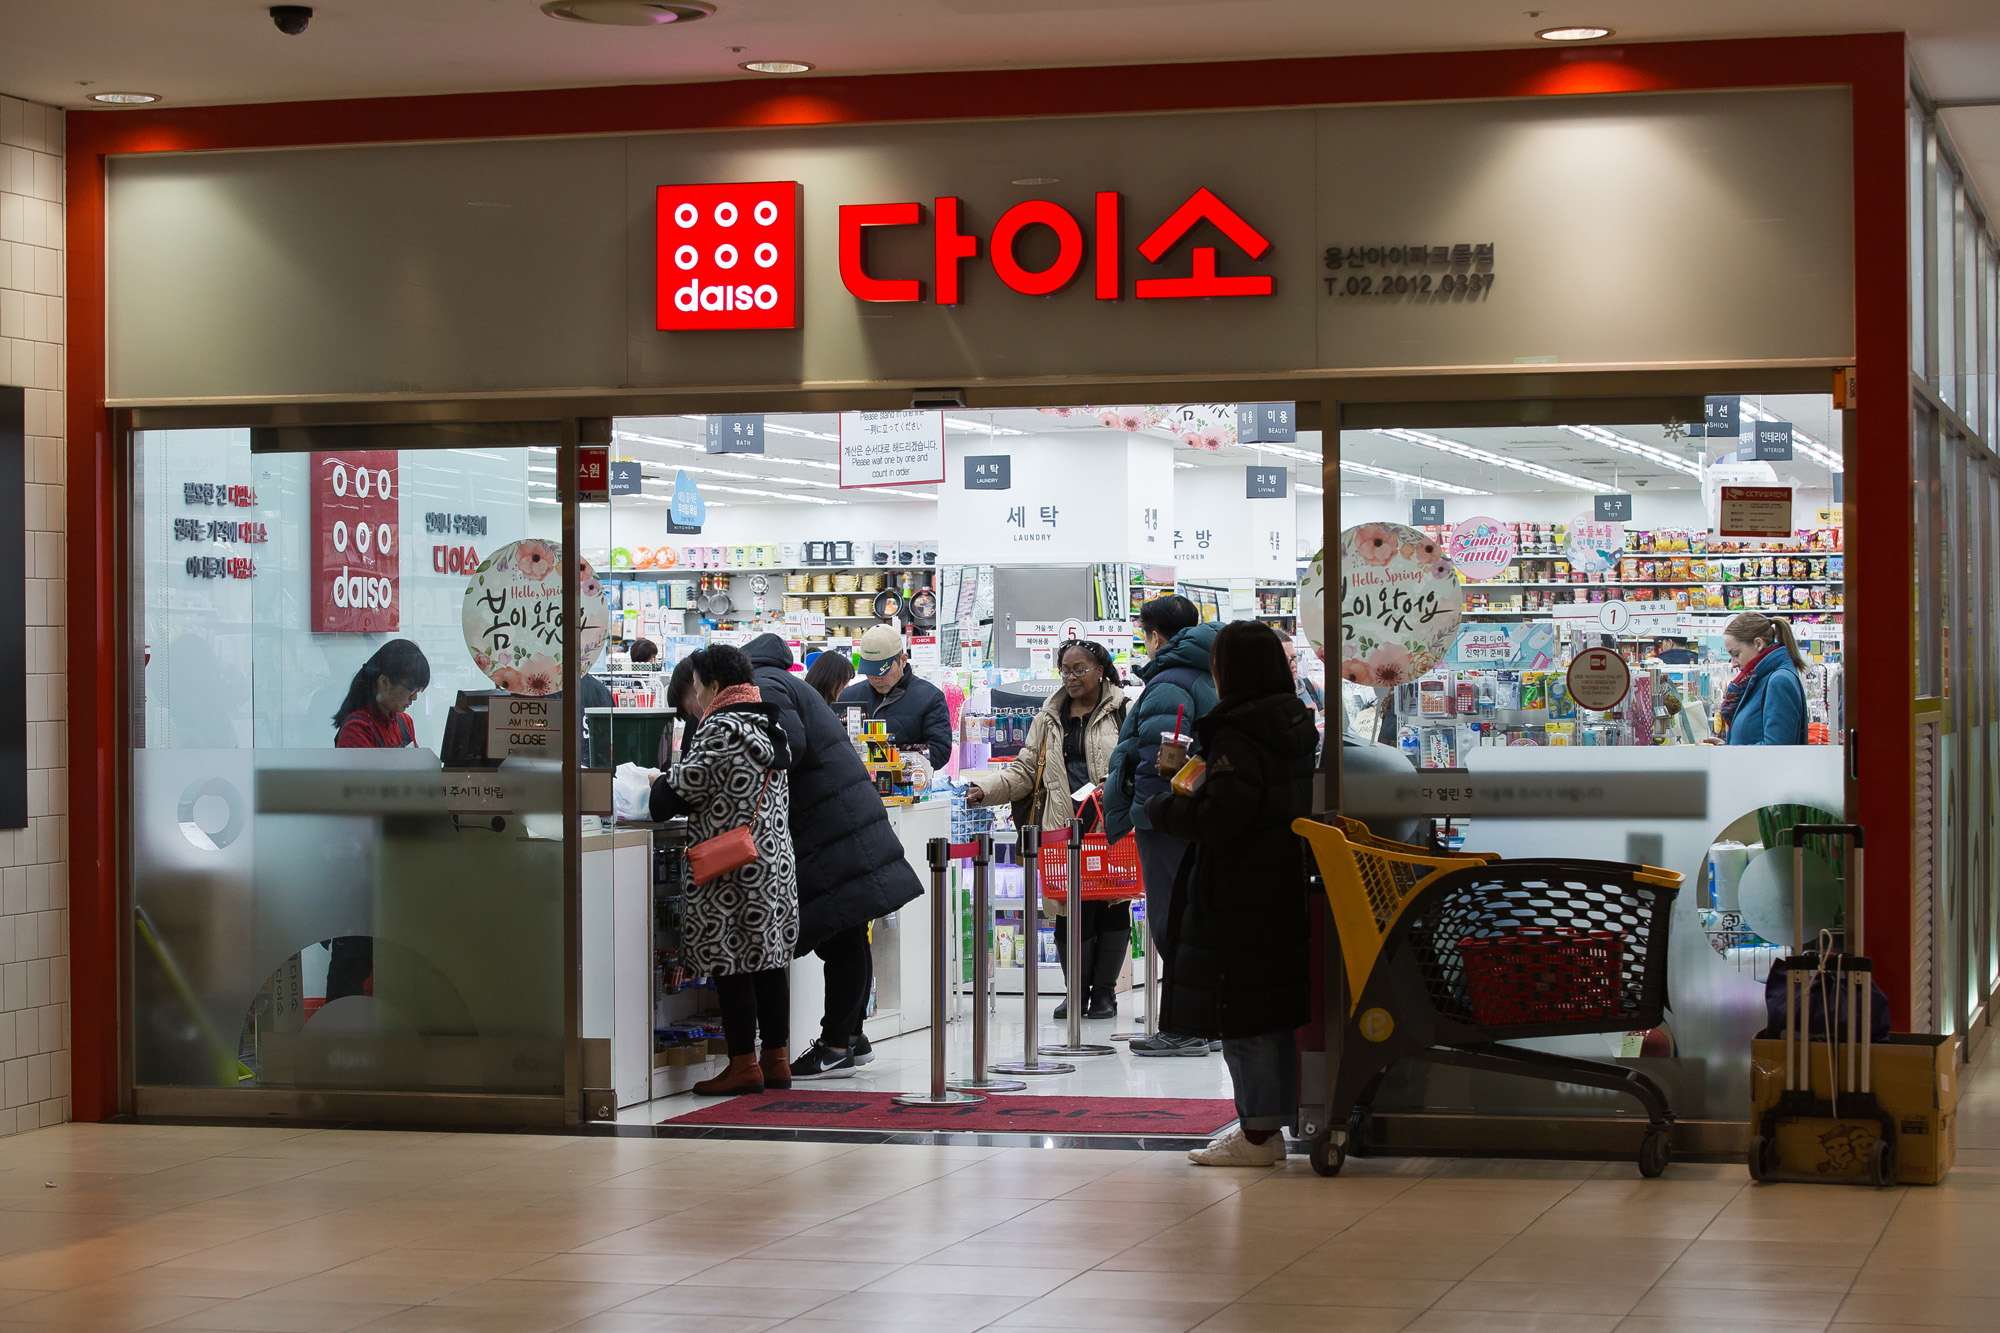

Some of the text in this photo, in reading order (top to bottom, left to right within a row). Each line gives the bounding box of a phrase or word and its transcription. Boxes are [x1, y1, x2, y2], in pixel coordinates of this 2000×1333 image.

[838, 186, 1273, 306] 다이소
[1323, 243, 1494, 270] 용산아이파크몰점
[1323, 273, 1495, 297] T.02.2012.0337
[674, 278, 778, 312] daiso
[1267, 410, 1288, 424] 미용
[732, 422, 755, 436] 욕실
[864, 421, 923, 435] 一列に立ってください
[1760, 431, 1788, 444] 인테리어
[844, 444, 863, 457] 계산은
[865, 443, 890, 456] 순서대로
[852, 453, 928, 467] Please wait one by one and
[579, 463, 600, 479] 스원
[872, 467, 910, 478] count in order
[975, 463, 999, 475] 세탁
[1256, 474, 1277, 485] 리빙
[183, 482, 214, 506] 필요한
[1420, 505, 1437, 515] 식품
[1603, 501, 1622, 511] 완구
[425, 511, 452, 534] 언제나
[1006, 505, 1059, 528] 세탁
[1013, 534, 1052, 542] LAUNDRY
[1577, 525, 1612, 538] 보들보들
[1460, 531, 1511, 548] Cookie
[1576, 538, 1612, 550] 인형모음
[433, 545, 480, 575] 다이소
[1455, 546, 1509, 566] candy
[1352, 568, 1424, 588] Hello, Spring
[333, 565, 392, 609] daiso
[510, 582, 563, 600] Hello, Spri
[1377, 587, 1454, 633] 왔어요
[1640, 603, 1666, 612] 파우치
[476, 587, 527, 651] 봄이
[1609, 609, 1617, 625] 1
[1099, 624, 1123, 632] 화장품
[1565, 621, 1572, 629] 8
[1800, 627, 1807, 637] 4
[741, 633, 753, 642] 23
[1068, 626, 1077, 640] 5
[1472, 635, 1504, 644] 우리 아이
[1465, 648, 1511, 658] 신학기 준비물
[1022, 682, 1060, 693] Cosme
[509, 701, 547, 716] OPEN
[508, 718, 548, 727] AM 10:00
[509, 733, 547, 746] CLOSE
[450, 785, 481, 798] 주시기
[1436, 787, 1460, 801] 열린
